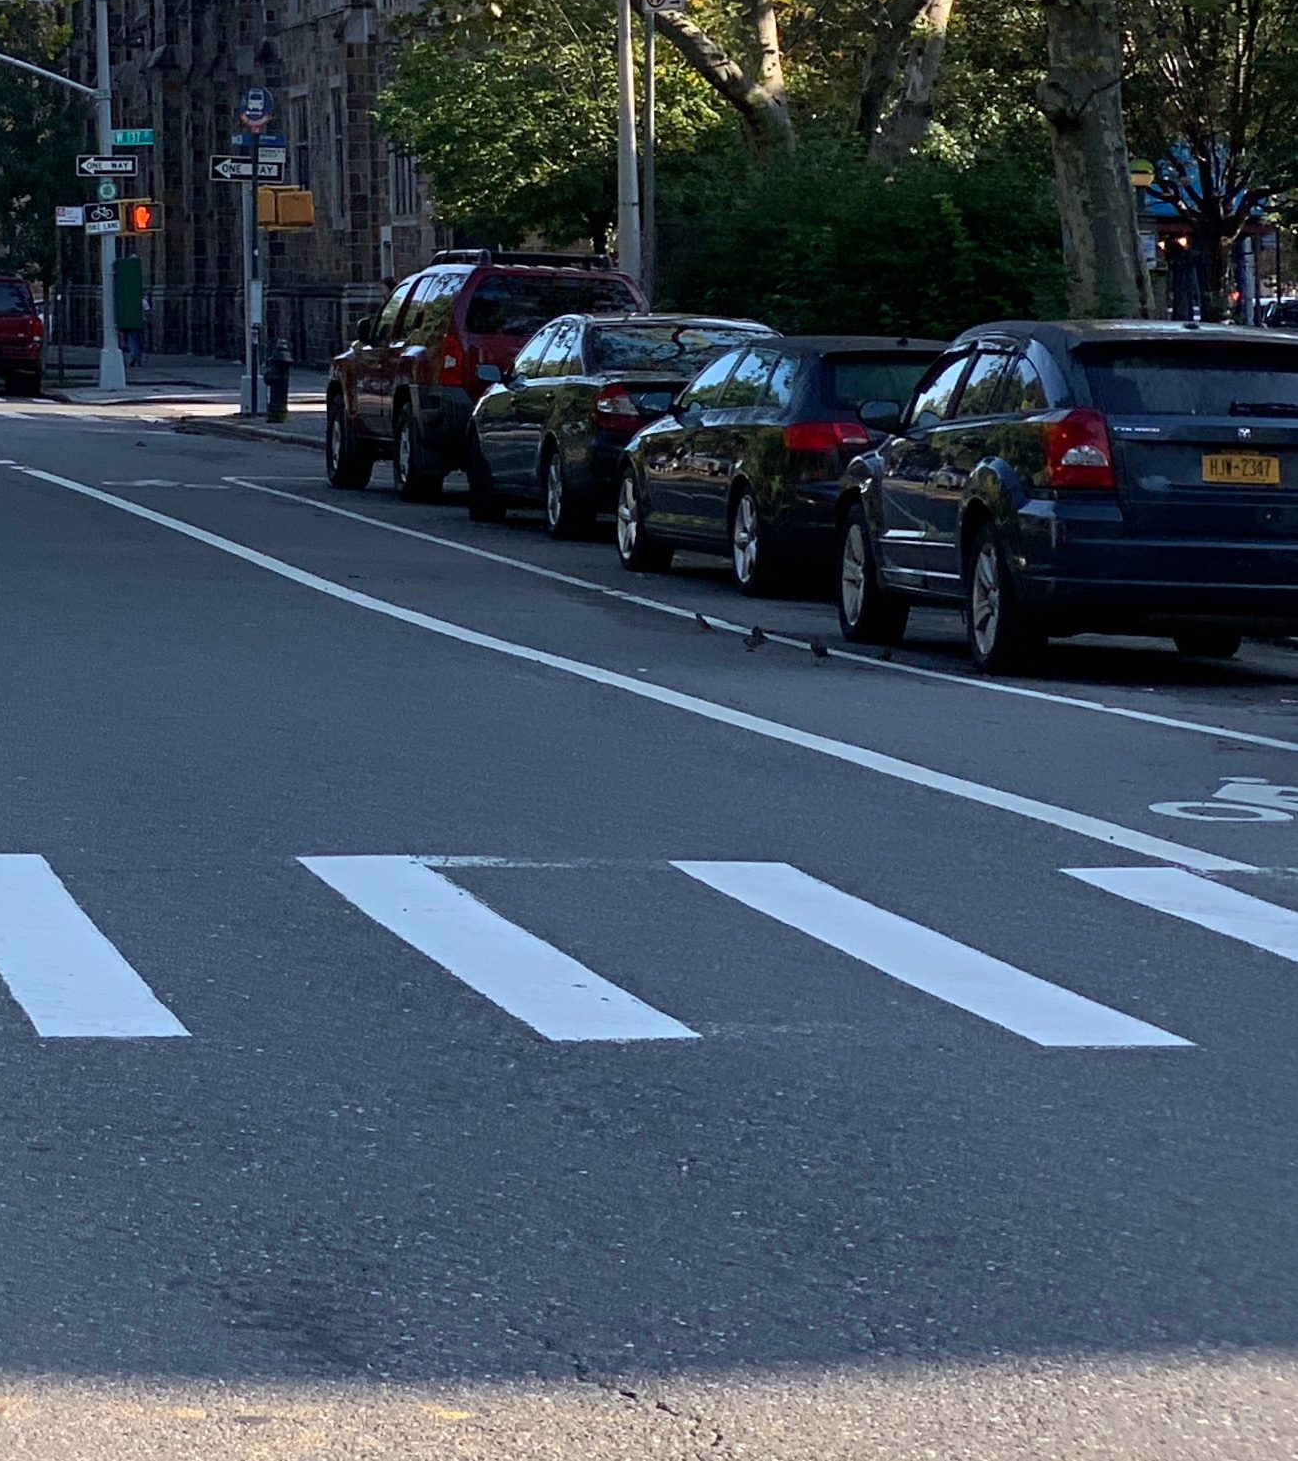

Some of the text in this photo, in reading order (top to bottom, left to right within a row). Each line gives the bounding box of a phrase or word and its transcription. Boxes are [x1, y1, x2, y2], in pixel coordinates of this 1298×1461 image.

[115, 132, 124, 143] W
[127, 131, 141, 143] 137
[86, 162, 129, 170] ONE WAY
[221, 164, 242, 174] ONE
